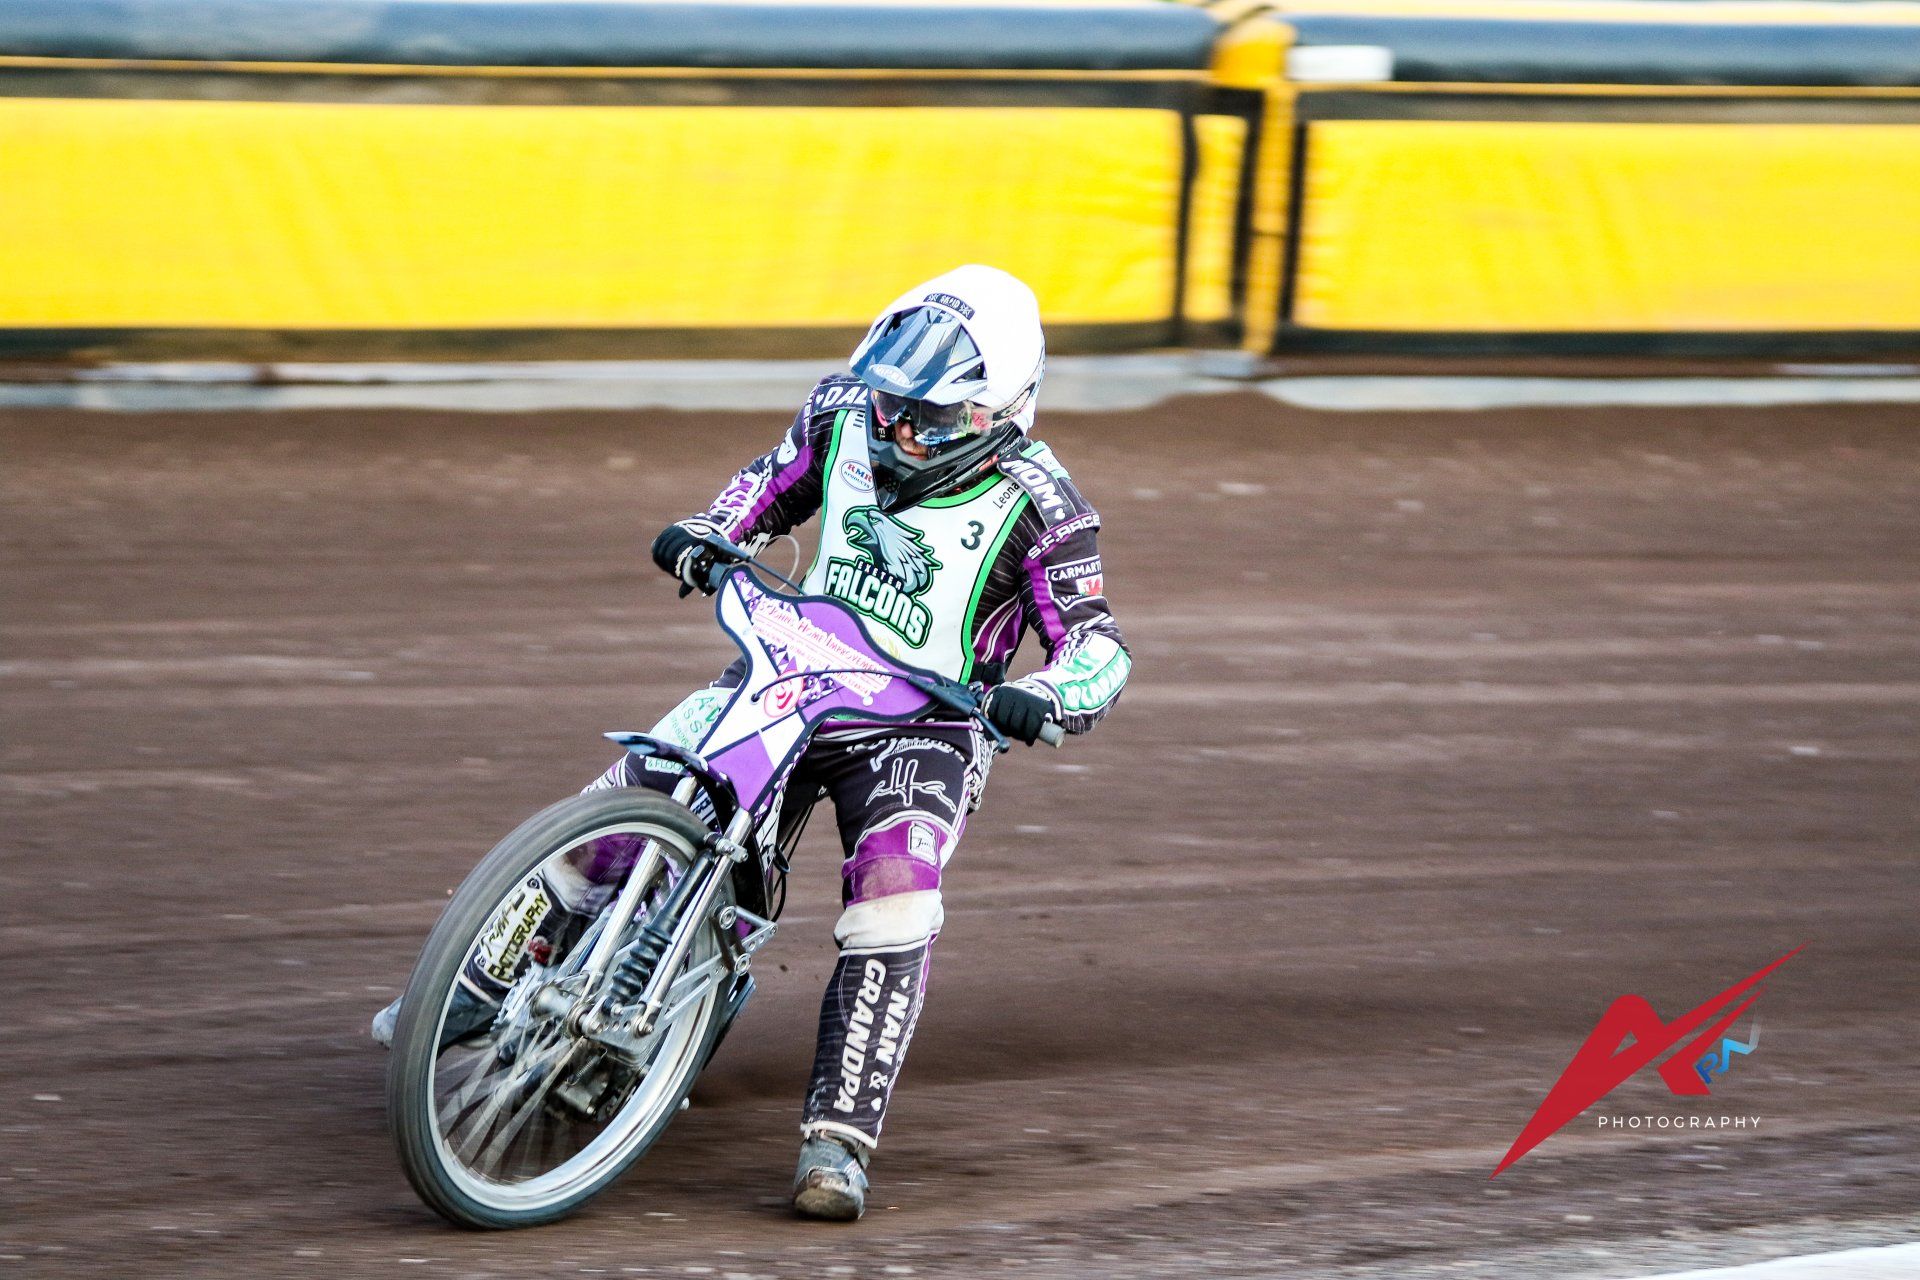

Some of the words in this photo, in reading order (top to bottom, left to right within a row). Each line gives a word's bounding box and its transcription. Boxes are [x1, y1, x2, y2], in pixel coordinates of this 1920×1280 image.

[846, 463, 872, 482] RMR
[1001, 459, 1064, 509] MOM
[960, 520, 985, 551] 3
[858, 561, 902, 590] EXETER
[825, 562, 927, 644] FALCONS
[833, 958, 887, 1113] GRANDPA
[875, 990, 910, 1066] NAN
[868, 1070, 889, 1090] &
